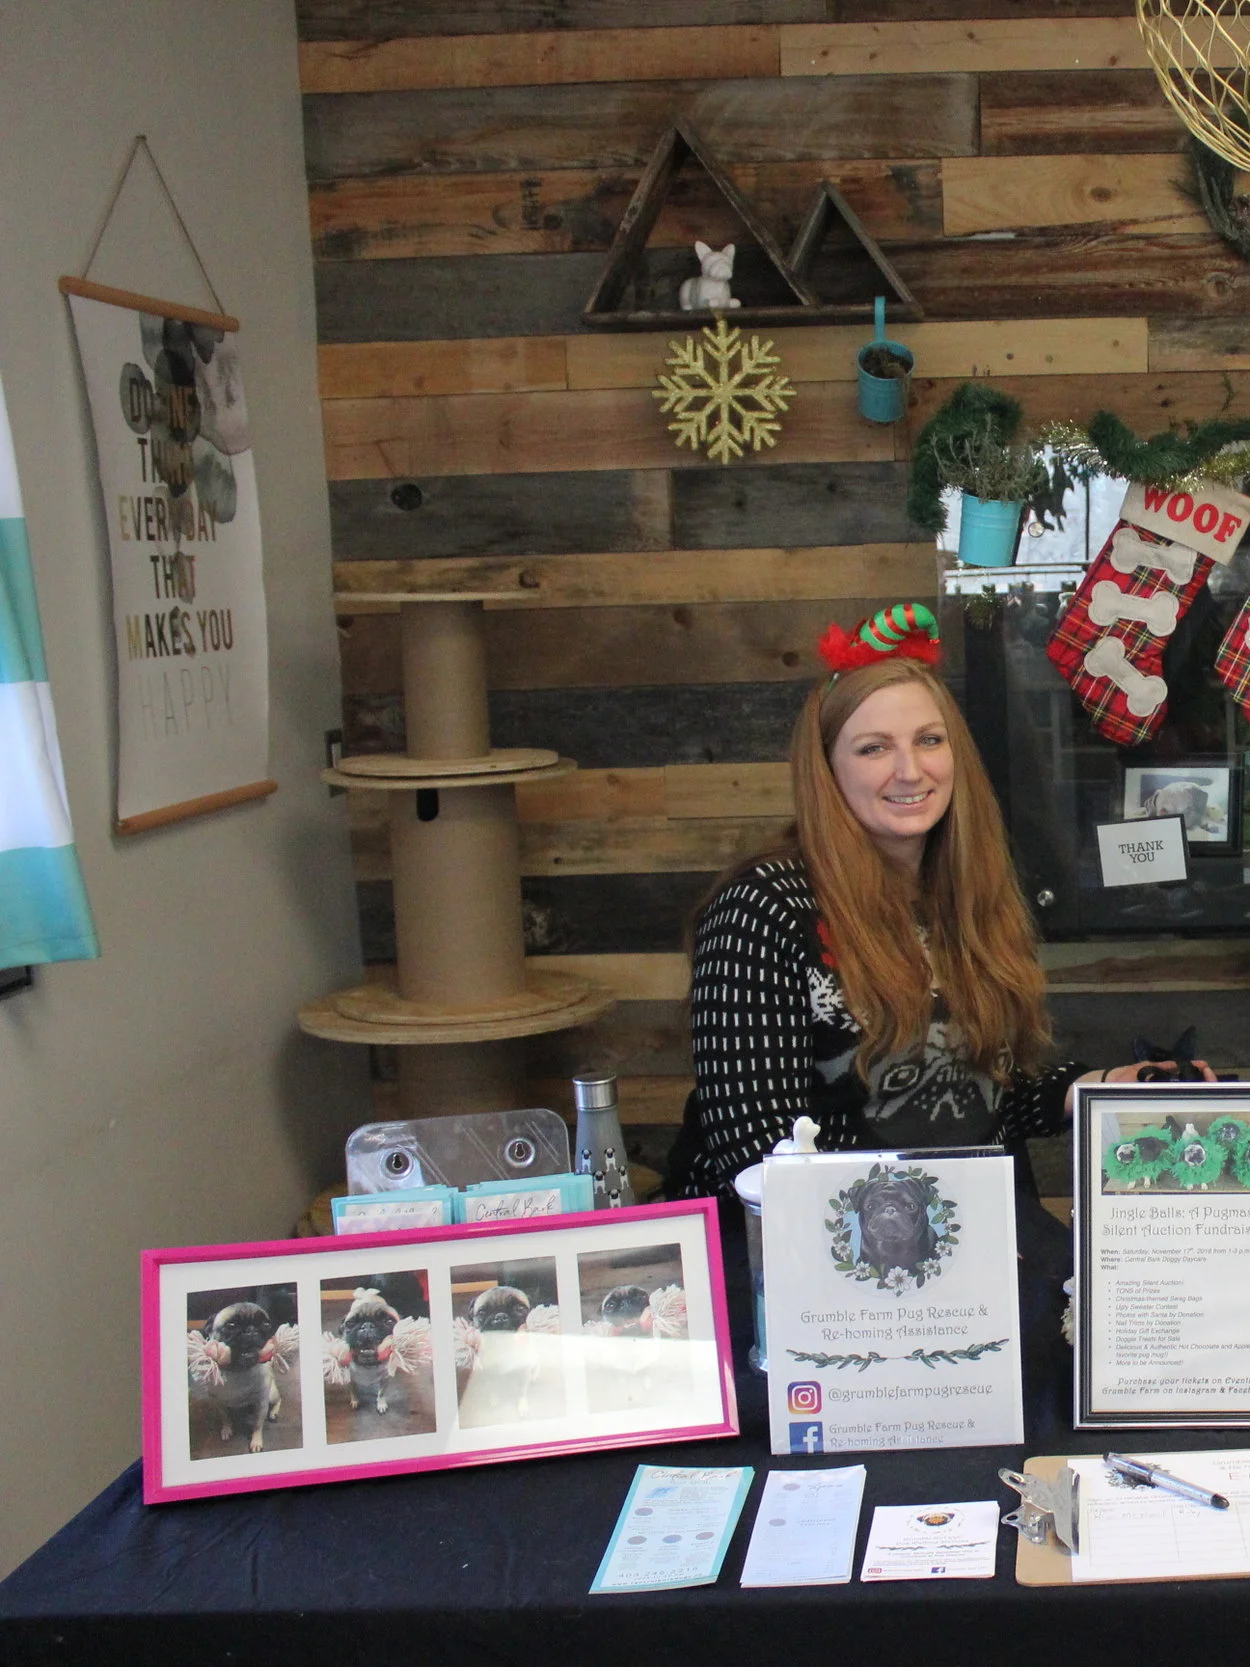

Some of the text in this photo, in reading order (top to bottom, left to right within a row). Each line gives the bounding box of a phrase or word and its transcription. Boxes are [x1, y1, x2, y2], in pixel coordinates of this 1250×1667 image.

[1143, 486, 1243, 544] WOOF
[149, 553, 196, 600] THAT
[125, 609, 233, 660] MAKES YOU
[138, 662, 235, 742] HAPPY
[1118, 840, 1164, 854] THANK
[1129, 851, 1156, 864] YOU
[1109, 1207, 1145, 1220] Jingle
[1149, 1206, 1185, 1219] Balls:
[1188, 1206, 1199, 1218] A
[1101, 1223, 1137, 1236] Silent
[1141, 1223, 1191, 1236] Auction
[800, 1304, 988, 1324] Grumble Farm Pug Rescue &
[821, 1324, 969, 1342] Re-homing Assistance
[1160, 1378, 1179, 1386] your
[828, 1383, 993, 1403] @grumblefarmpugrescue
[829, 1418, 975, 1435] Grumble Farm Pug Rescue &
[829, 1436, 886, 1448] Re-homing
